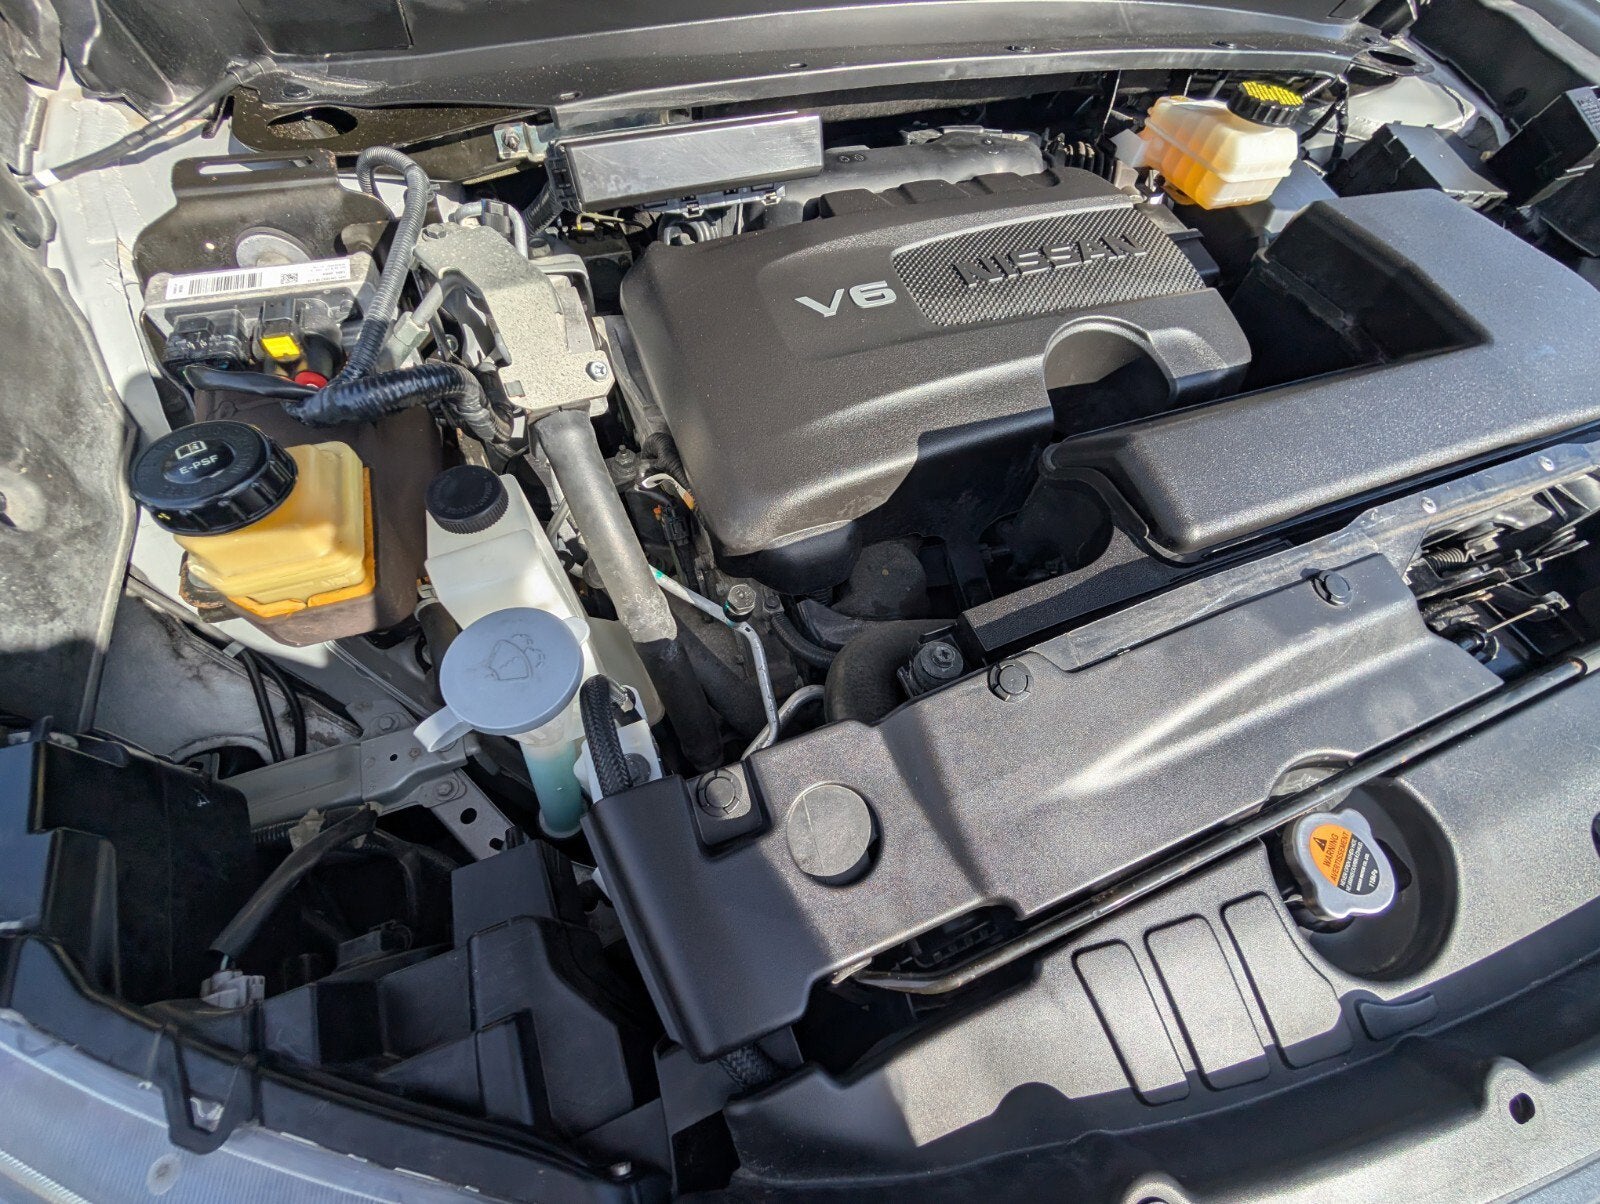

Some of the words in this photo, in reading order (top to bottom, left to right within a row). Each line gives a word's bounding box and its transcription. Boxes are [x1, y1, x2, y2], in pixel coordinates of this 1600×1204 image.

[952, 234, 1147, 288] NISSAN
[795, 280, 897, 318] V6
[179, 454, 218, 475] E-PSF
[1323, 833, 1339, 867] WARNING
[1331, 831, 1349, 881] AVERTISSEMENT
